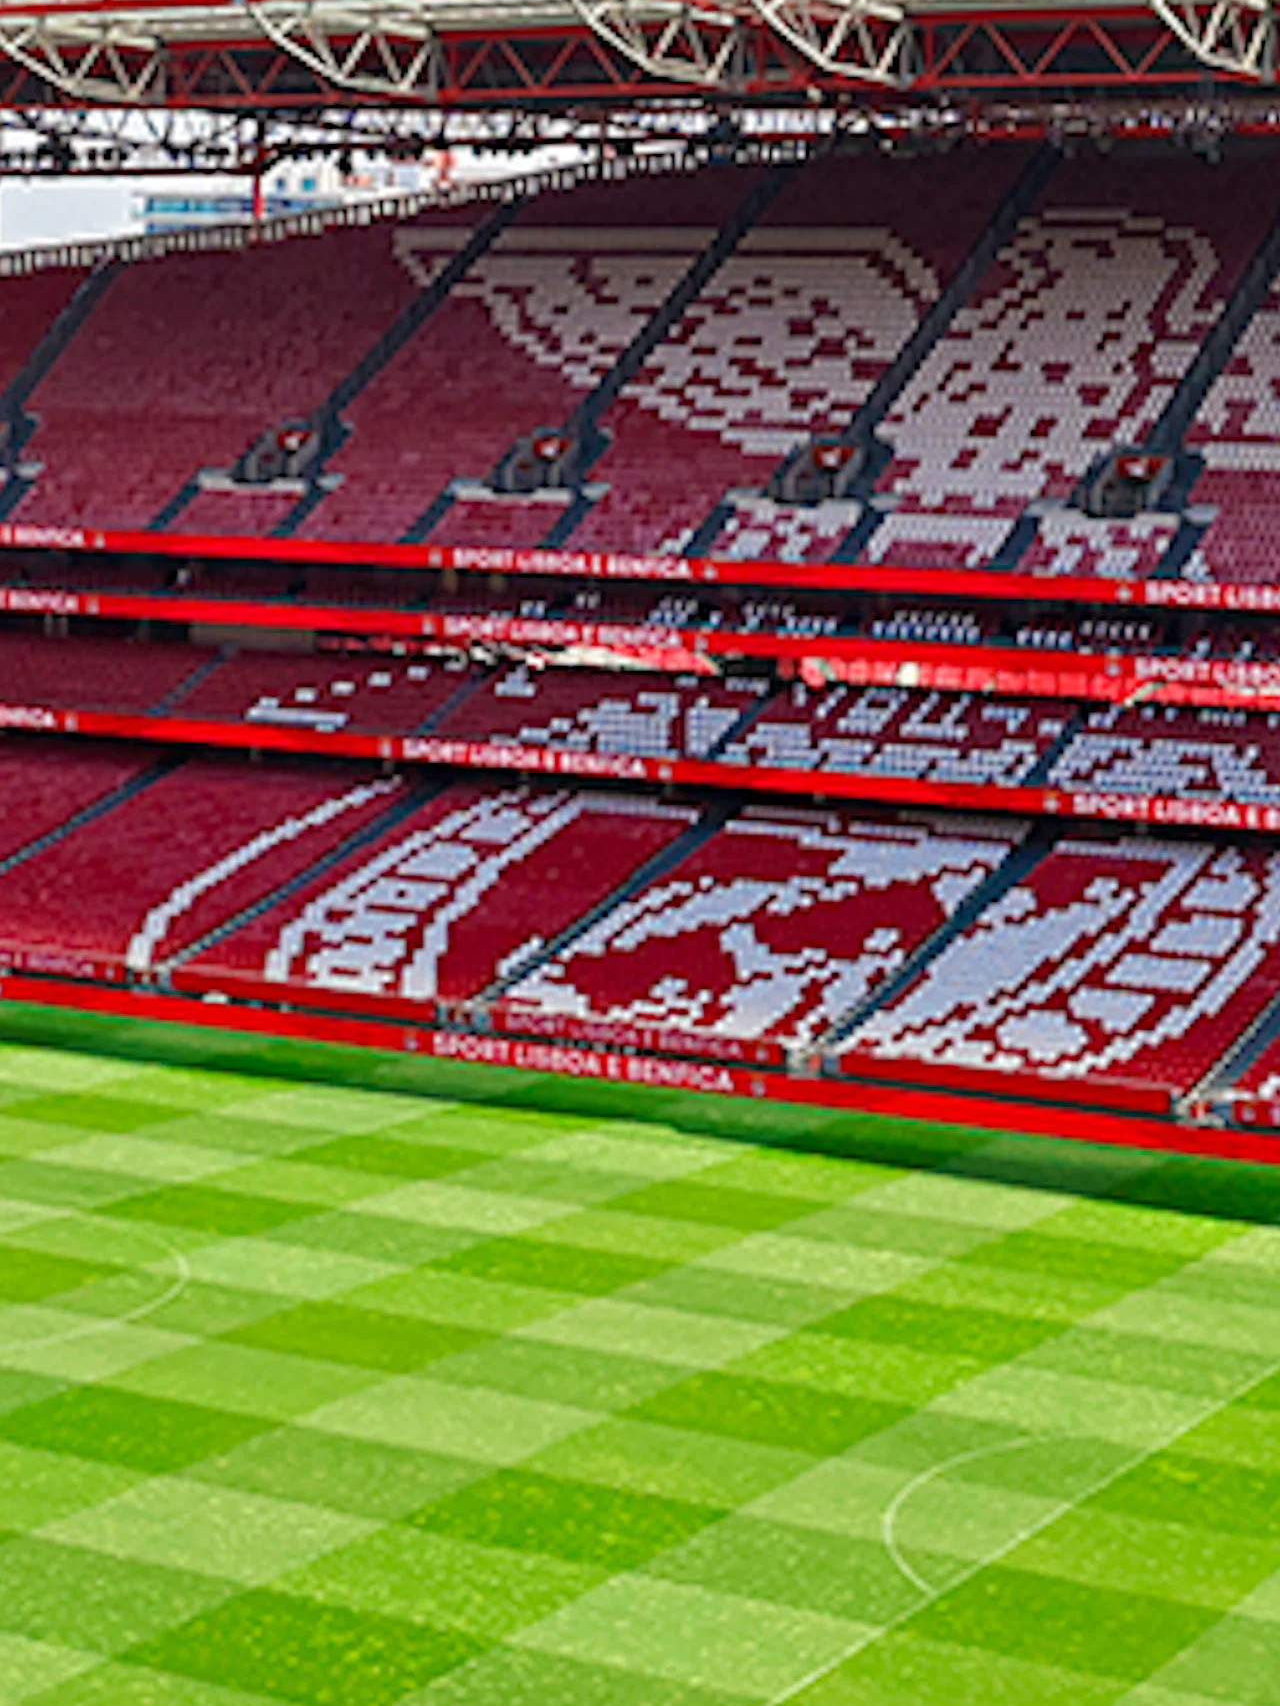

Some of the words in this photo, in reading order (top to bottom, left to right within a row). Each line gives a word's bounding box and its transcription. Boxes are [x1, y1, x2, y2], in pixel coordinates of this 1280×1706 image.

[453, 548, 514, 570] SPORT
[591, 554, 601, 573] E
[607, 554, 691, 579] BENFICA
[1145, 579, 1220, 606] SPORT
[443, 616, 507, 639] SPORT
[1134, 655, 1208, 682] SPORT
[403, 739, 467, 762] SPORT
[544, 748, 554, 769] E
[560, 749, 646, 778] BENFICA
[1073, 792, 1148, 820] SPORT
[1154, 796, 1240, 825] LISBOA
[1247, 804, 1259, 827] E
[433, 1032, 509, 1061] SPORT
[514, 1041, 601, 1075] LISBOA
[608, 1054, 619, 1078] E
[627, 1057, 734, 1092] BENFICA
